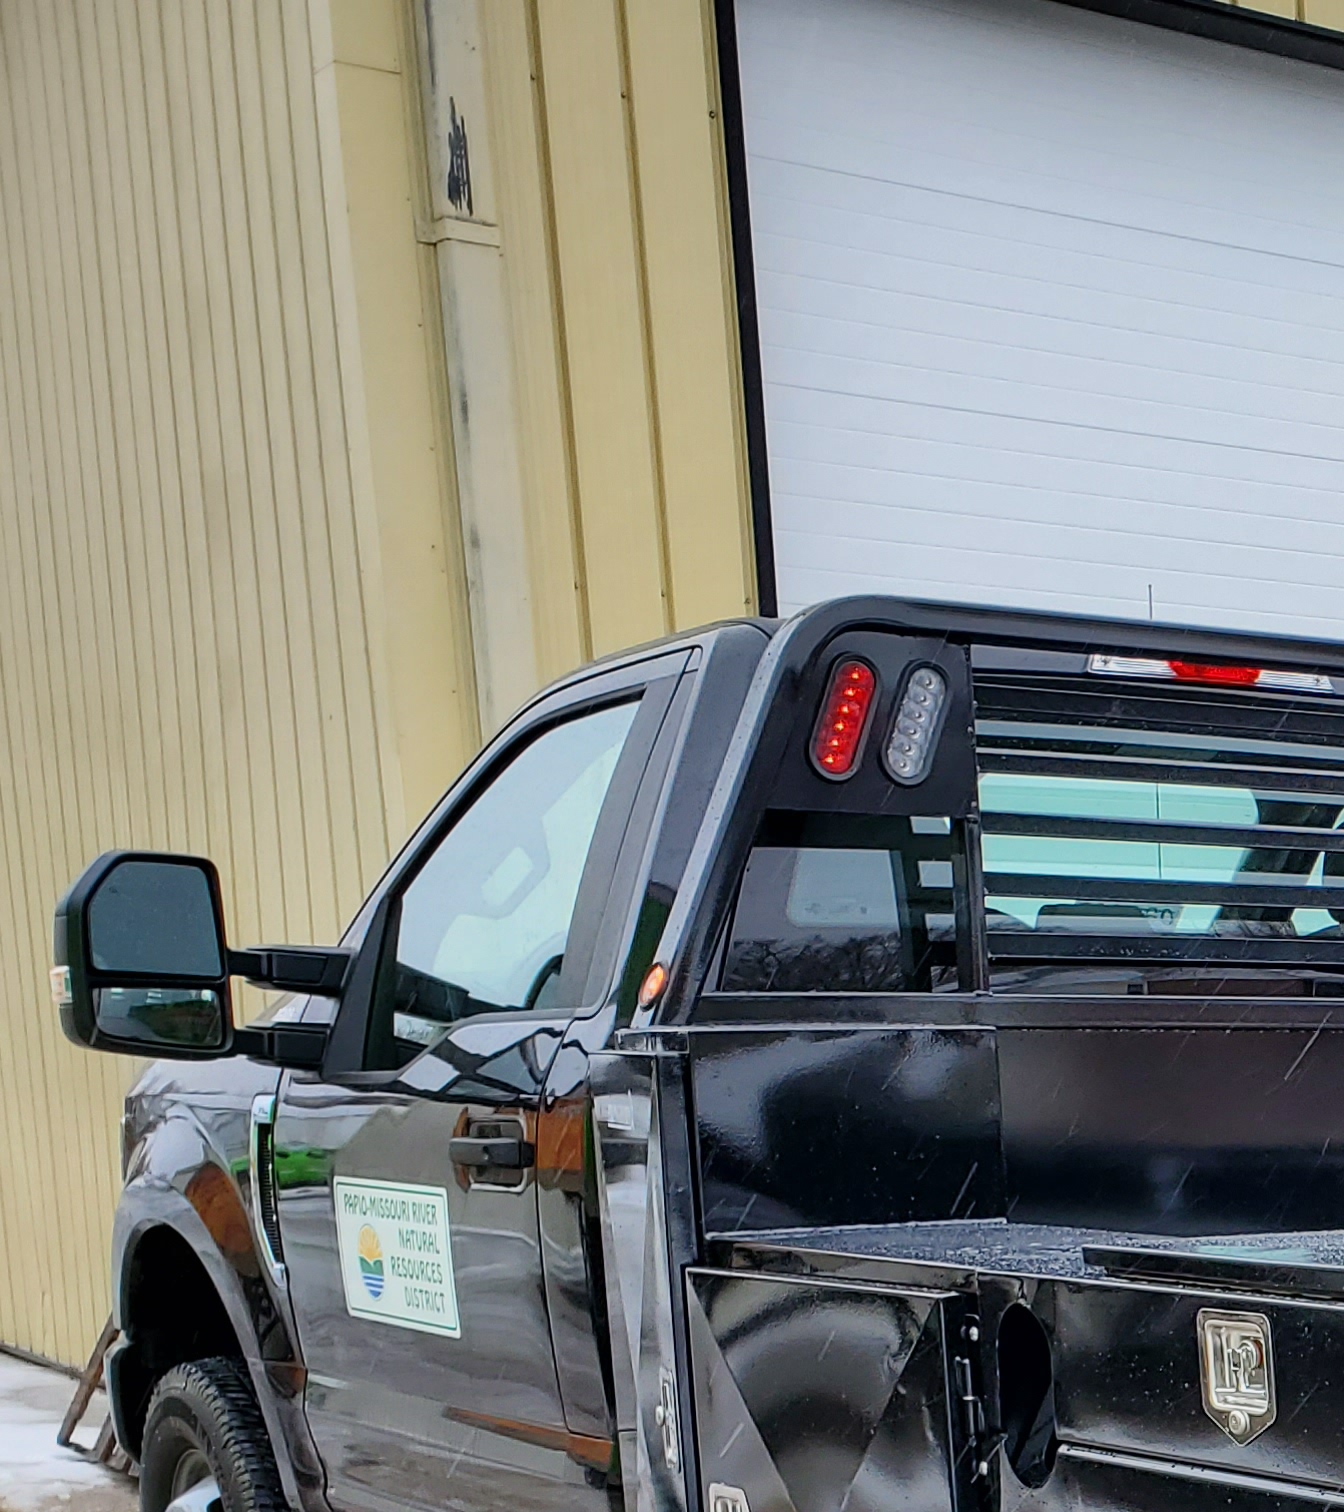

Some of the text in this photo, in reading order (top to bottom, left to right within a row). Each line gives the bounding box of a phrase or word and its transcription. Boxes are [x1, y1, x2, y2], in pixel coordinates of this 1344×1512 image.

[344, 1193, 438, 1226] PAPIO-MISSOURI RIVER
[398, 1228, 440, 1254] NATURAL
[390, 1256, 443, 1284] RESOURCES
[404, 1286, 446, 1314] DISTRICT
